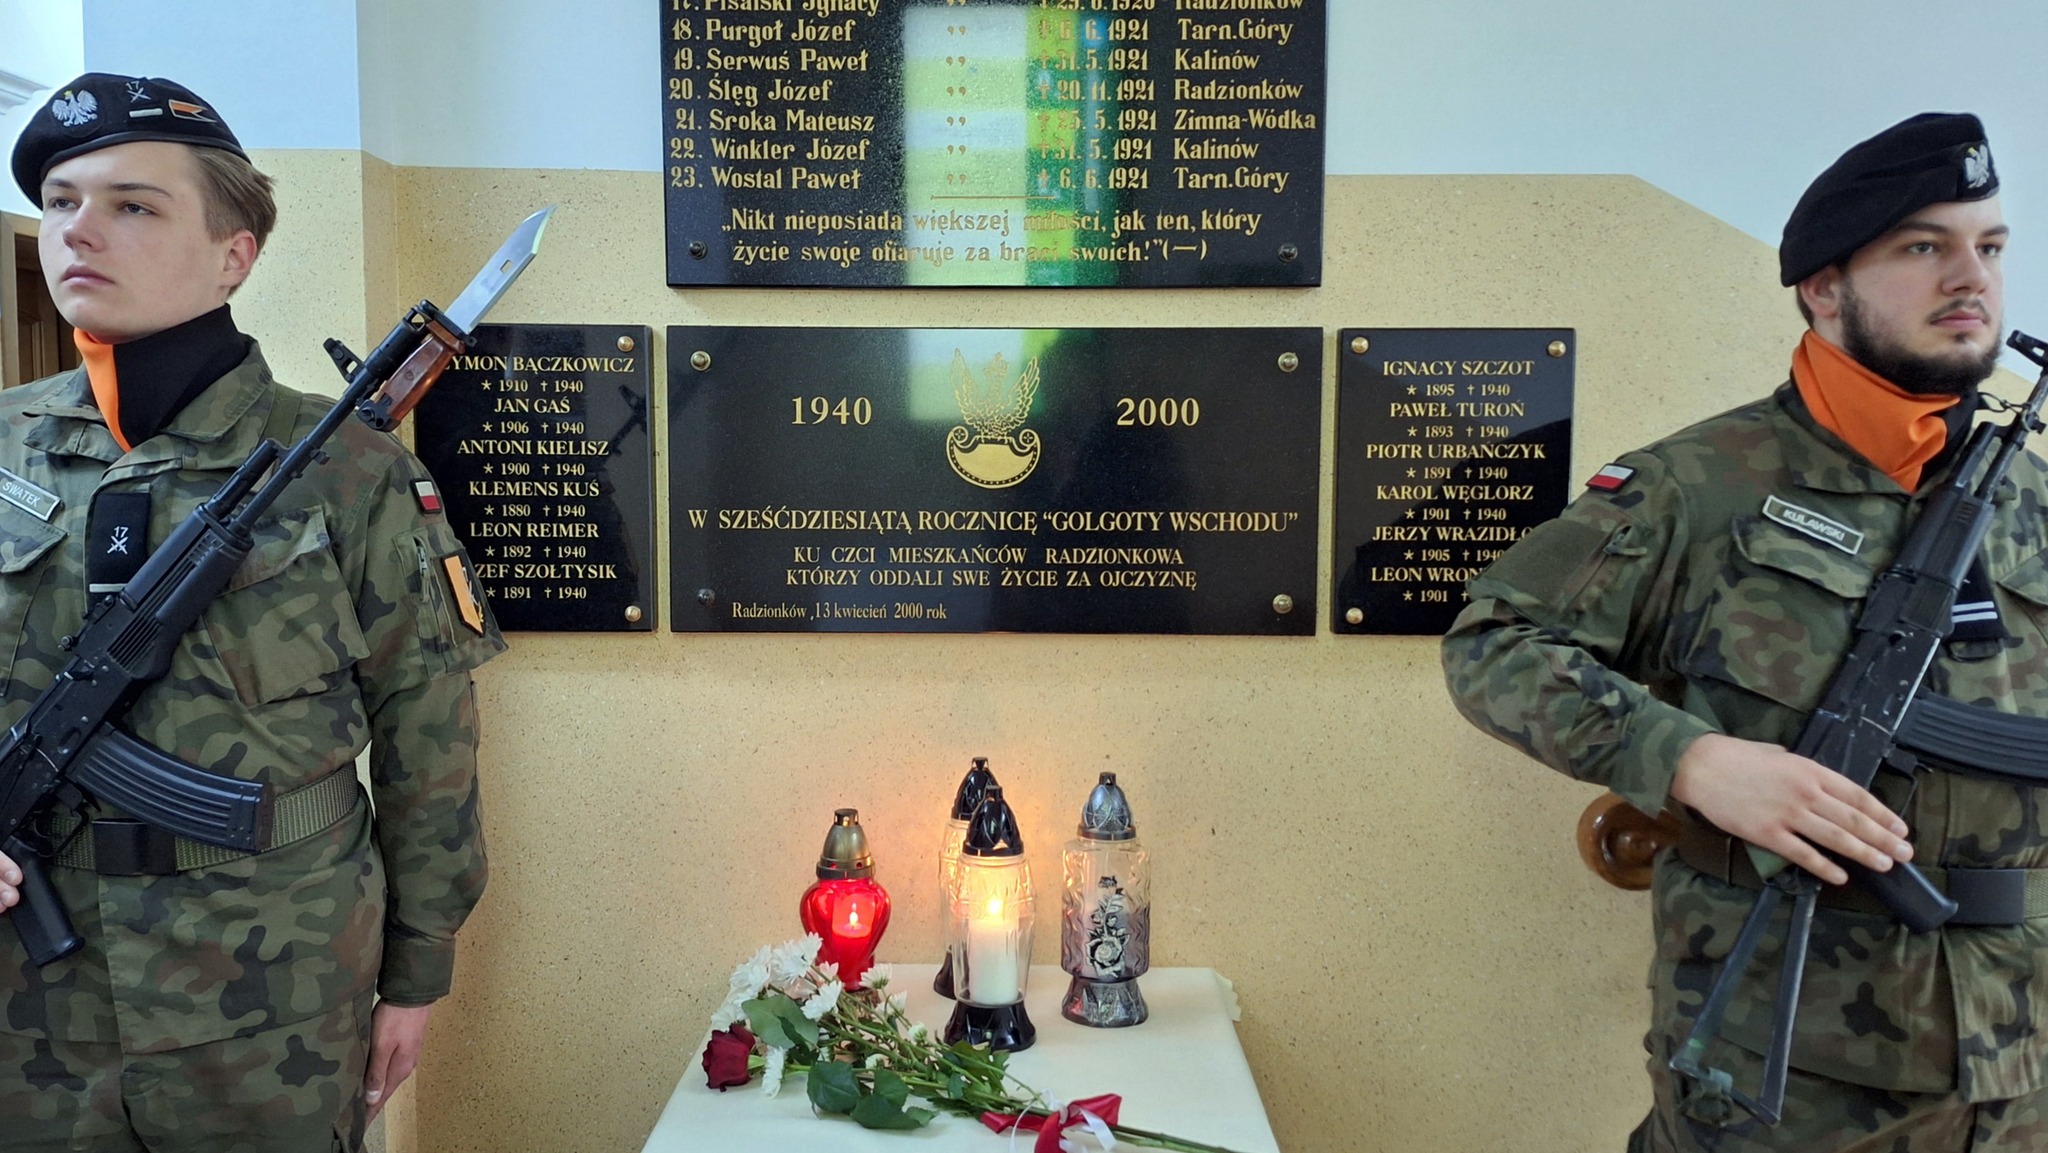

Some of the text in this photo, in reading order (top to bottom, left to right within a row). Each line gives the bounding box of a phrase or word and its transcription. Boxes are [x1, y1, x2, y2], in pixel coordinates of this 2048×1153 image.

[672, 19, 700, 41] 18.
[791, 19, 856, 41] Józef
[673, 48, 701, 71] 19.
[706, 48, 790, 71] Serwuś
[801, 48, 869, 71] Paweł
[1174, 48, 1260, 71] Kalinów
[669, 78, 701, 101] 20.
[708, 72, 758, 107] Ślęg
[768, 79, 833, 101] Józef
[1173, 78, 1304, 100] Radzionków
[676, 108, 702, 131] 21.
[709, 109, 777, 131] Sroka
[786, 109, 875, 132] Mateusz
[1173, 108, 1316, 130] Zimna-Wódka
[670, 138, 702, 160] 22.
[711, 137, 795, 160] Winkler
[806, 138, 870, 161] Józef
[1173, 138, 1259, 160] Kalinów
[670, 167, 703, 189] 23.
[711, 167, 783, 189] Wostal
[791, 167, 862, 190] Paweł
[913, 209, 1010, 237] większej
[1111, 209, 1146, 238] jak
[1156, 209, 1197, 233] ten,
[1201, 209, 1262, 236] który
[733, 240, 790, 265] życie
[801, 241, 862, 268] swoje
[872, 240, 954, 267] ofiaruje
[965, 246, 991, 262] za
[1000, 241, 1058, 262] braci
[445, 355, 634, 374] YMON BĄCZKOWICZ
[1383, 361, 1535, 376] IGNACY SZCZOT
[500, 380, 584, 393] 1910 1940
[1426, 384, 1511, 397] 1895 1940
[494, 395, 570, 414] JAN GAŚ
[791, 396, 873, 426] 1940
[1116, 397, 1200, 426] 2000
[1390, 399, 1525, 417] PAWEŁ TUROŃ
[500, 422, 584, 434] 1906 1940
[1424, 425, 1509, 438] 1893 1940
[457, 440, 609, 456] ANTONI KIELISZ
[1367, 440, 1546, 459] PIOTR URBAŃCZYK
[501, 463, 585, 475] 1900 1940
[1424, 467, 1508, 479] 1891 1940
[469, 480, 600, 497] KLEMENS KUŚ
[1377, 485, 1534, 503] KAROL WĘGLORZ
[502, 504, 586, 517] 1880 1940
[1422, 508, 1507, 520] 1901 1940
[688, 509, 708, 529] W
[719, 505, 912, 535] SZEŚĆDZIESIĄTĄ
[918, 510, 1037, 536] ROCZNICĘ
[114, 526, 129, 539] 17
[470, 523, 599, 538] LEON REIMER
[1372, 526, 1432, 541] JERZY
[503, 546, 587, 558] 1892 1940
[793, 543, 1184, 565] KU CZCI MIESZKAŃCÓW RADZIONKOWA
[1421, 549, 1451, 562] 1905
[475, 564, 617, 579] ZEF SZOŁTYSIK
[786, 566, 1197, 591] KTÓRZY ODDALI SWE ŻYCIE ZA OJCZYZNĘ
[1371, 567, 1483, 582] LEON WRON
[503, 587, 587, 599] 1891 1940
[1420, 589, 1448, 602] 1901
[732, 602, 807, 619] Radzionków
[834, 603, 887, 619] kwiecień
[894, 603, 923, 619] 2000
[926, 603, 947, 619] rok
